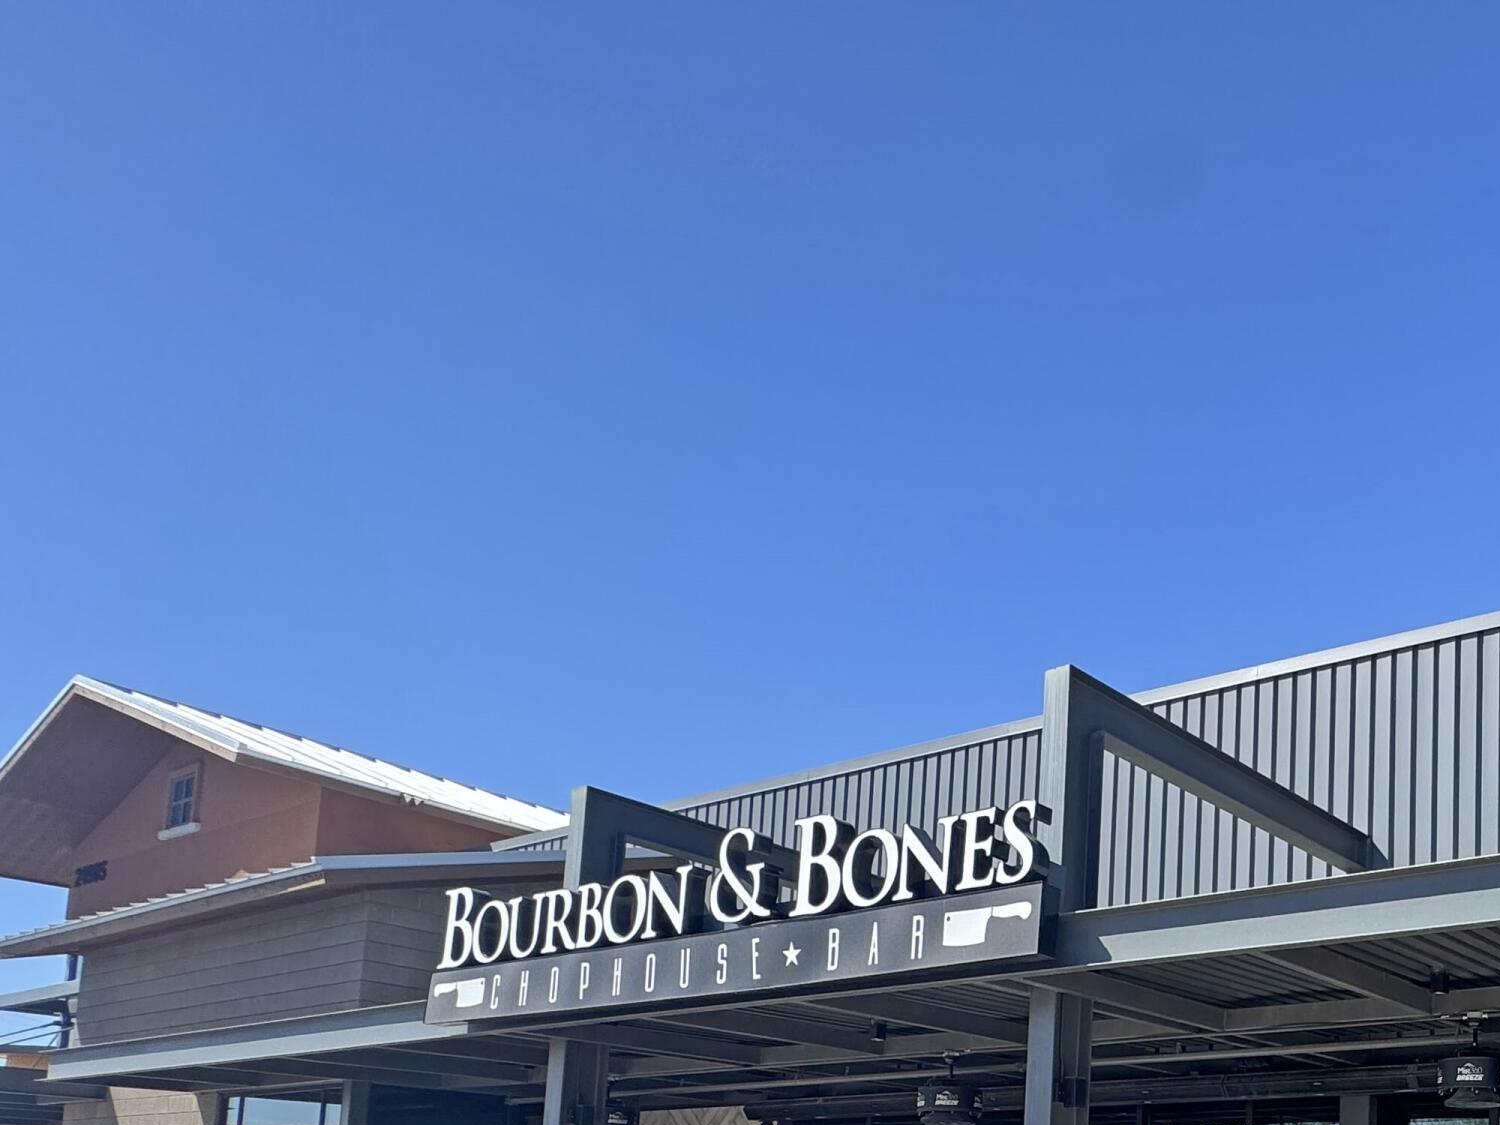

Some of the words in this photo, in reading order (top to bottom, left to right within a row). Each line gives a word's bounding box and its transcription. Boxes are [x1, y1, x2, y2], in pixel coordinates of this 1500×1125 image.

[437, 864, 693, 969] BOURBON
[709, 827, 771, 922] &
[789, 799, 1037, 918] BONES
[489, 943, 762, 1010] CHOPHOUSE
[827, 913, 925, 972] BAR
